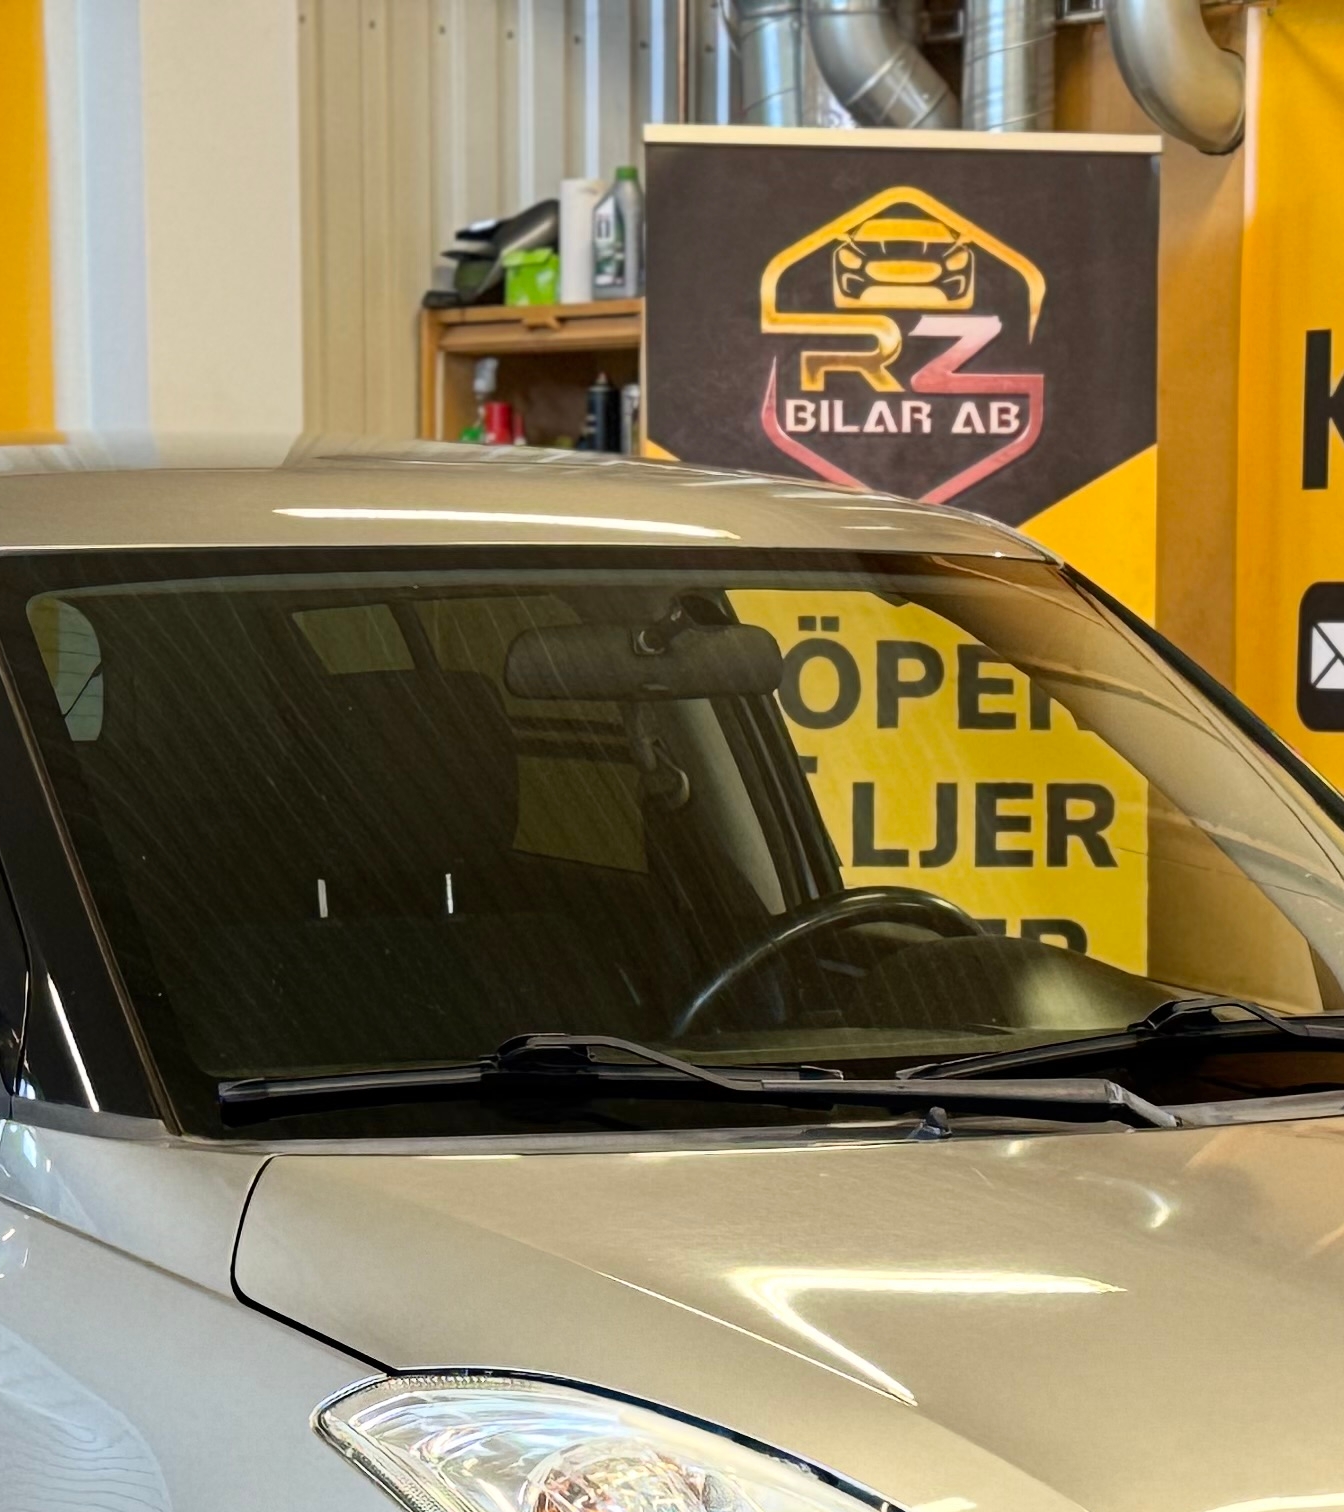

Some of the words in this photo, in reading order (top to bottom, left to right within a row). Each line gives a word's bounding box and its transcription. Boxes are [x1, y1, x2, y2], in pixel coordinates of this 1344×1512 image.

[761, 313, 1044, 393] RZ
[785, 399, 932, 434] BILAR
[951, 401, 1020, 434] AB
[776, 615, 1083, 731] ÖPE
[799, 756, 1118, 868] LJER
